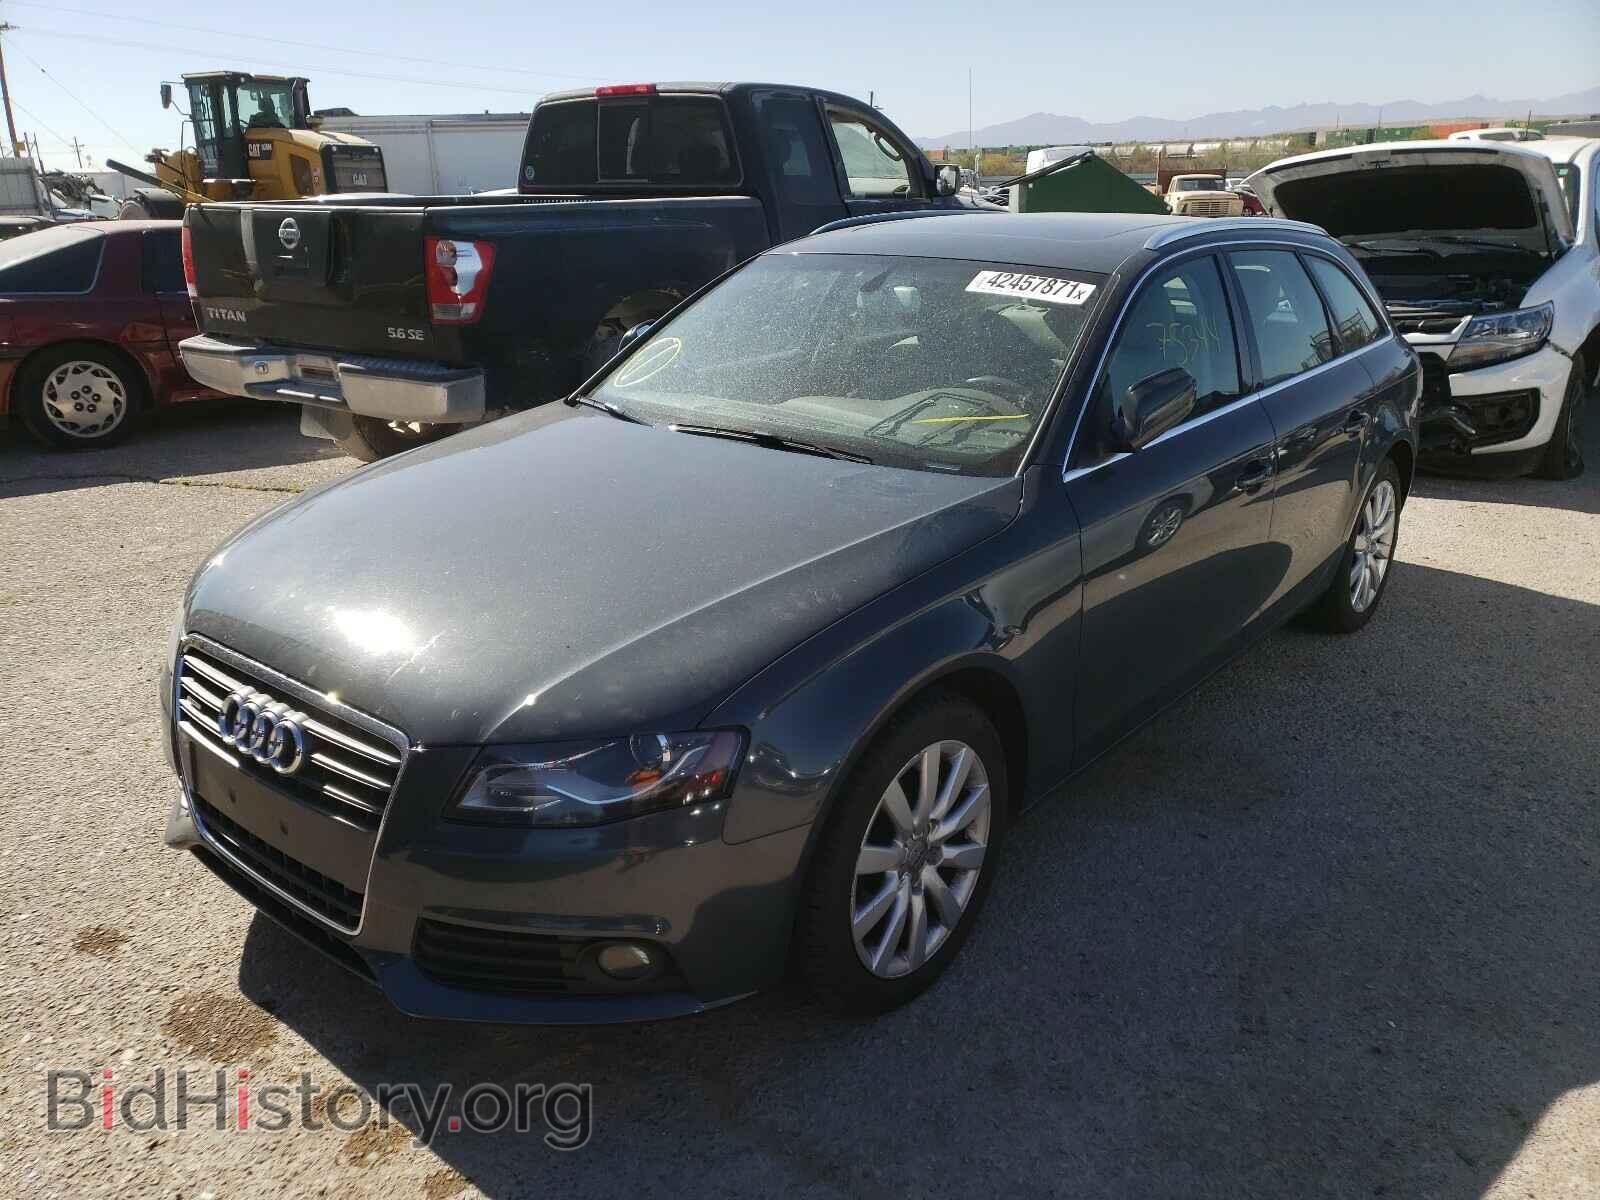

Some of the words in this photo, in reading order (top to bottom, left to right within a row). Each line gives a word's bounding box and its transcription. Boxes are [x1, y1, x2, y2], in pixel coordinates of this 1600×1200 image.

[248, 143, 261, 158] CAT
[353, 174, 368, 186] CAT
[206, 307, 247, 323] TITAN
[408, 328, 425, 341] SE
